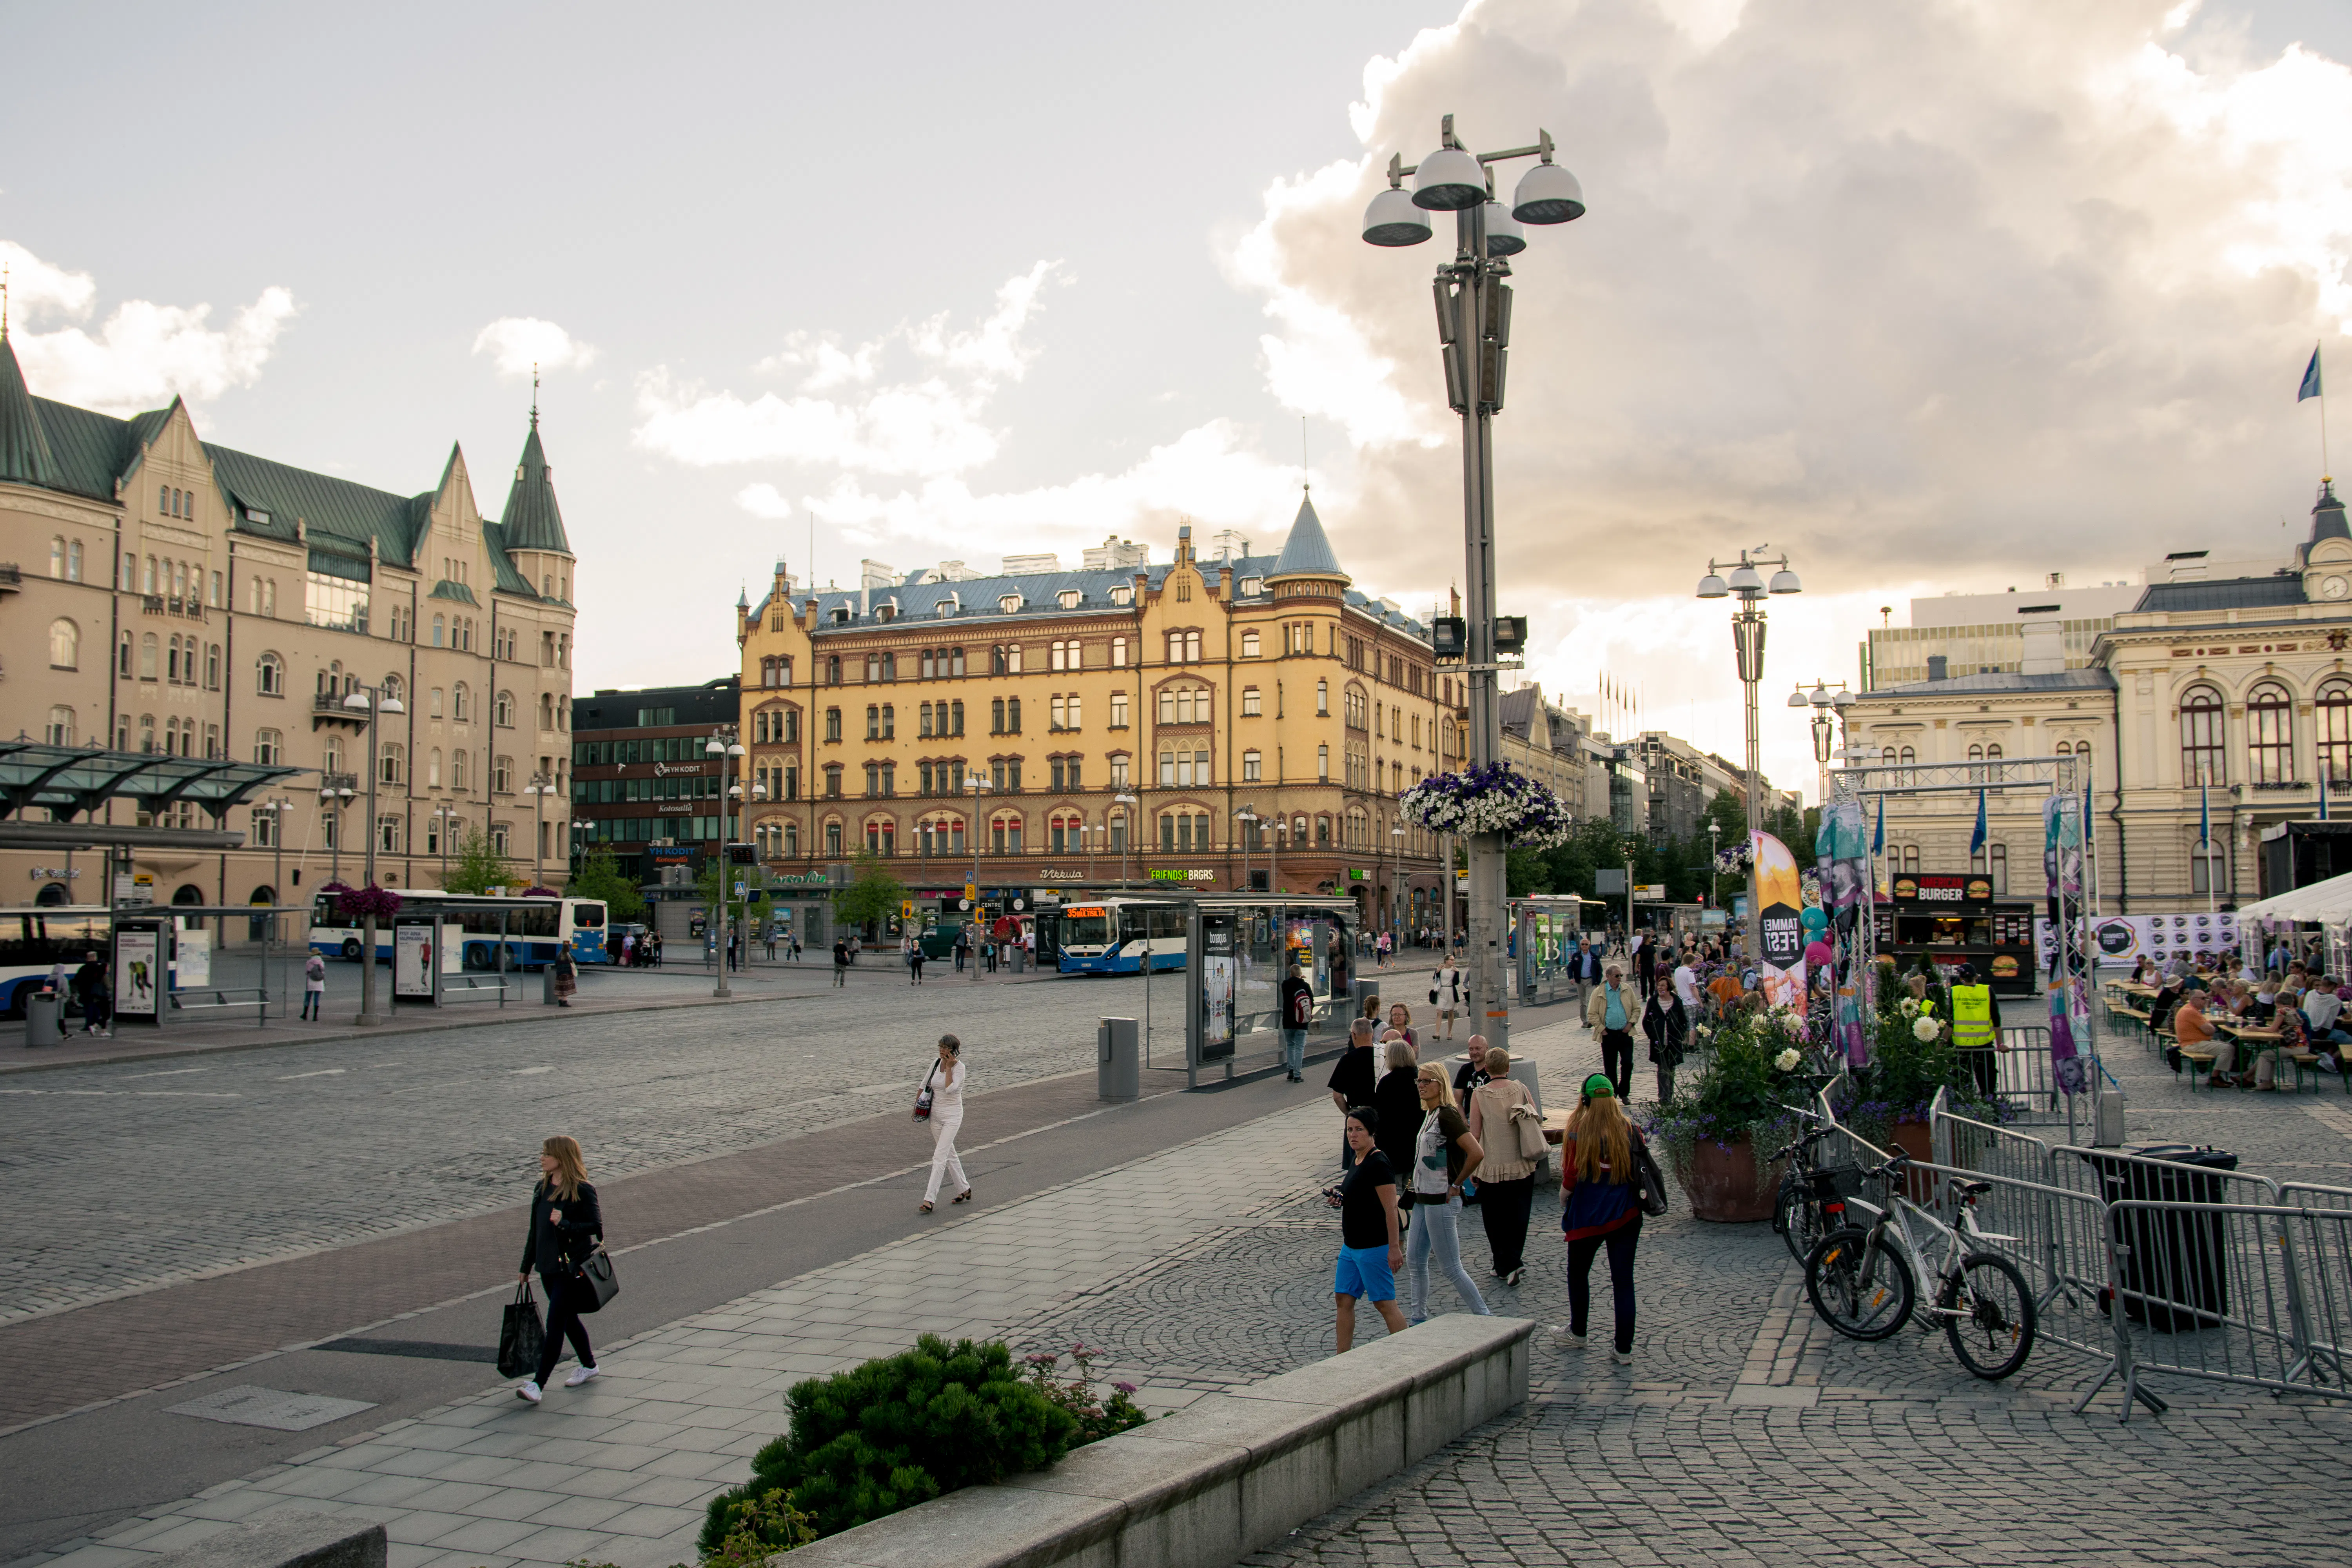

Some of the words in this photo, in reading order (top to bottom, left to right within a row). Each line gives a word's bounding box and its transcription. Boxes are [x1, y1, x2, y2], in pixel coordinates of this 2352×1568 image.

[1042, 869, 1084, 878] Vikkula
[1151, 870, 1183, 880] FRIENDS
[1188, 869, 1213, 880] BRGRS
[1919, 877, 1964, 888] AMERICAN
[1918, 888, 1964, 900] BURGER
[1067, 908, 1077, 918] 35
[1209, 931, 1227, 946] bonaqua
